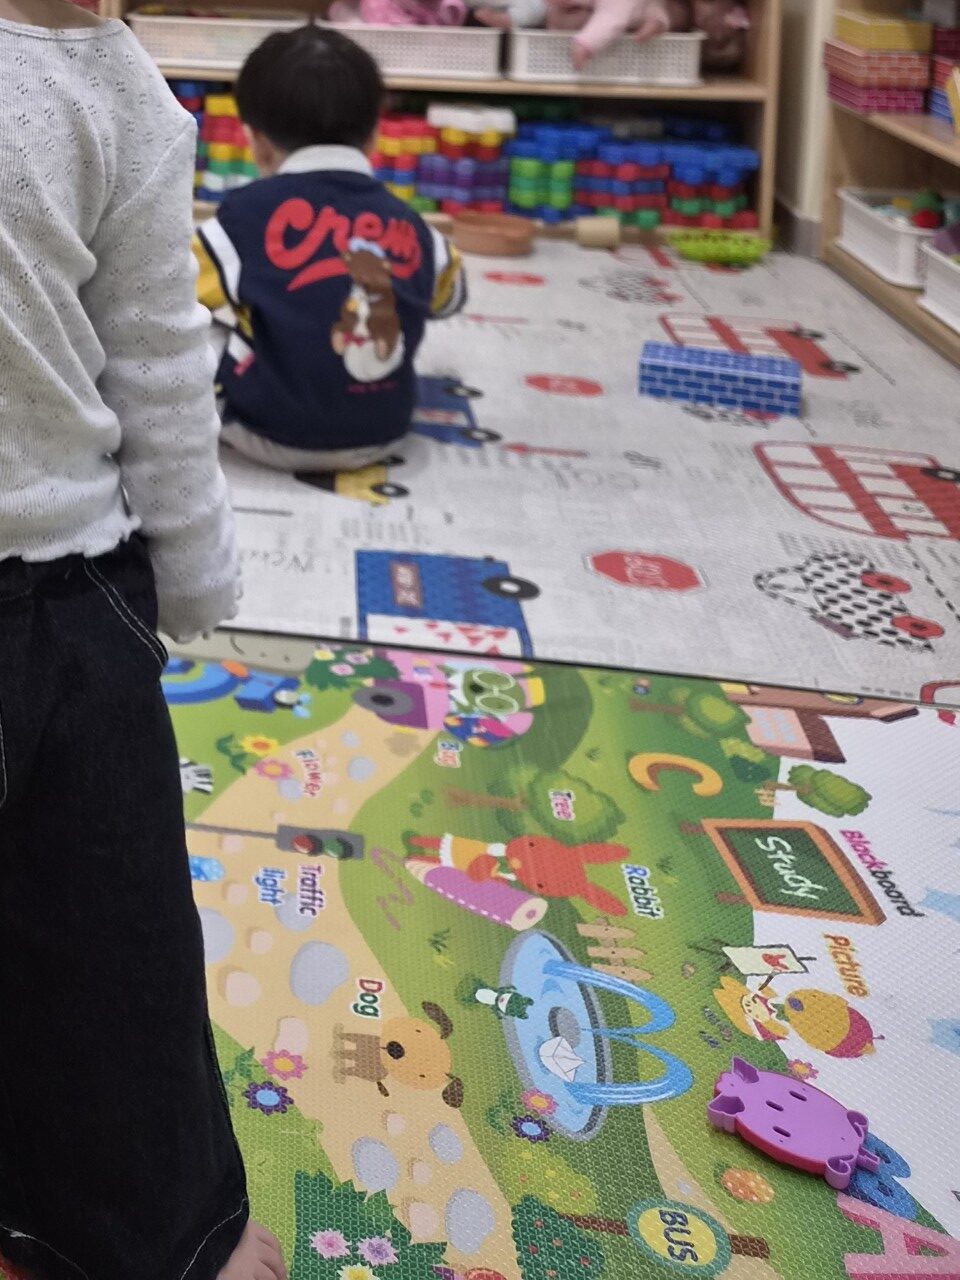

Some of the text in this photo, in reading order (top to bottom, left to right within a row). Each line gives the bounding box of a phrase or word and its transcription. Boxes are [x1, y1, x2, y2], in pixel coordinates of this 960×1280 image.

[296, 749, 322, 797] Flower
[255, 868, 285, 904] light
[299, 865, 324, 916] Traffic
[624, 864, 661, 917] Rabbit
[754, 835, 829, 901] Study
[840, 830, 925, 918] Blackboard
[352, 978, 383, 1017] Dog
[658, 1209, 699, 1263] BUS
